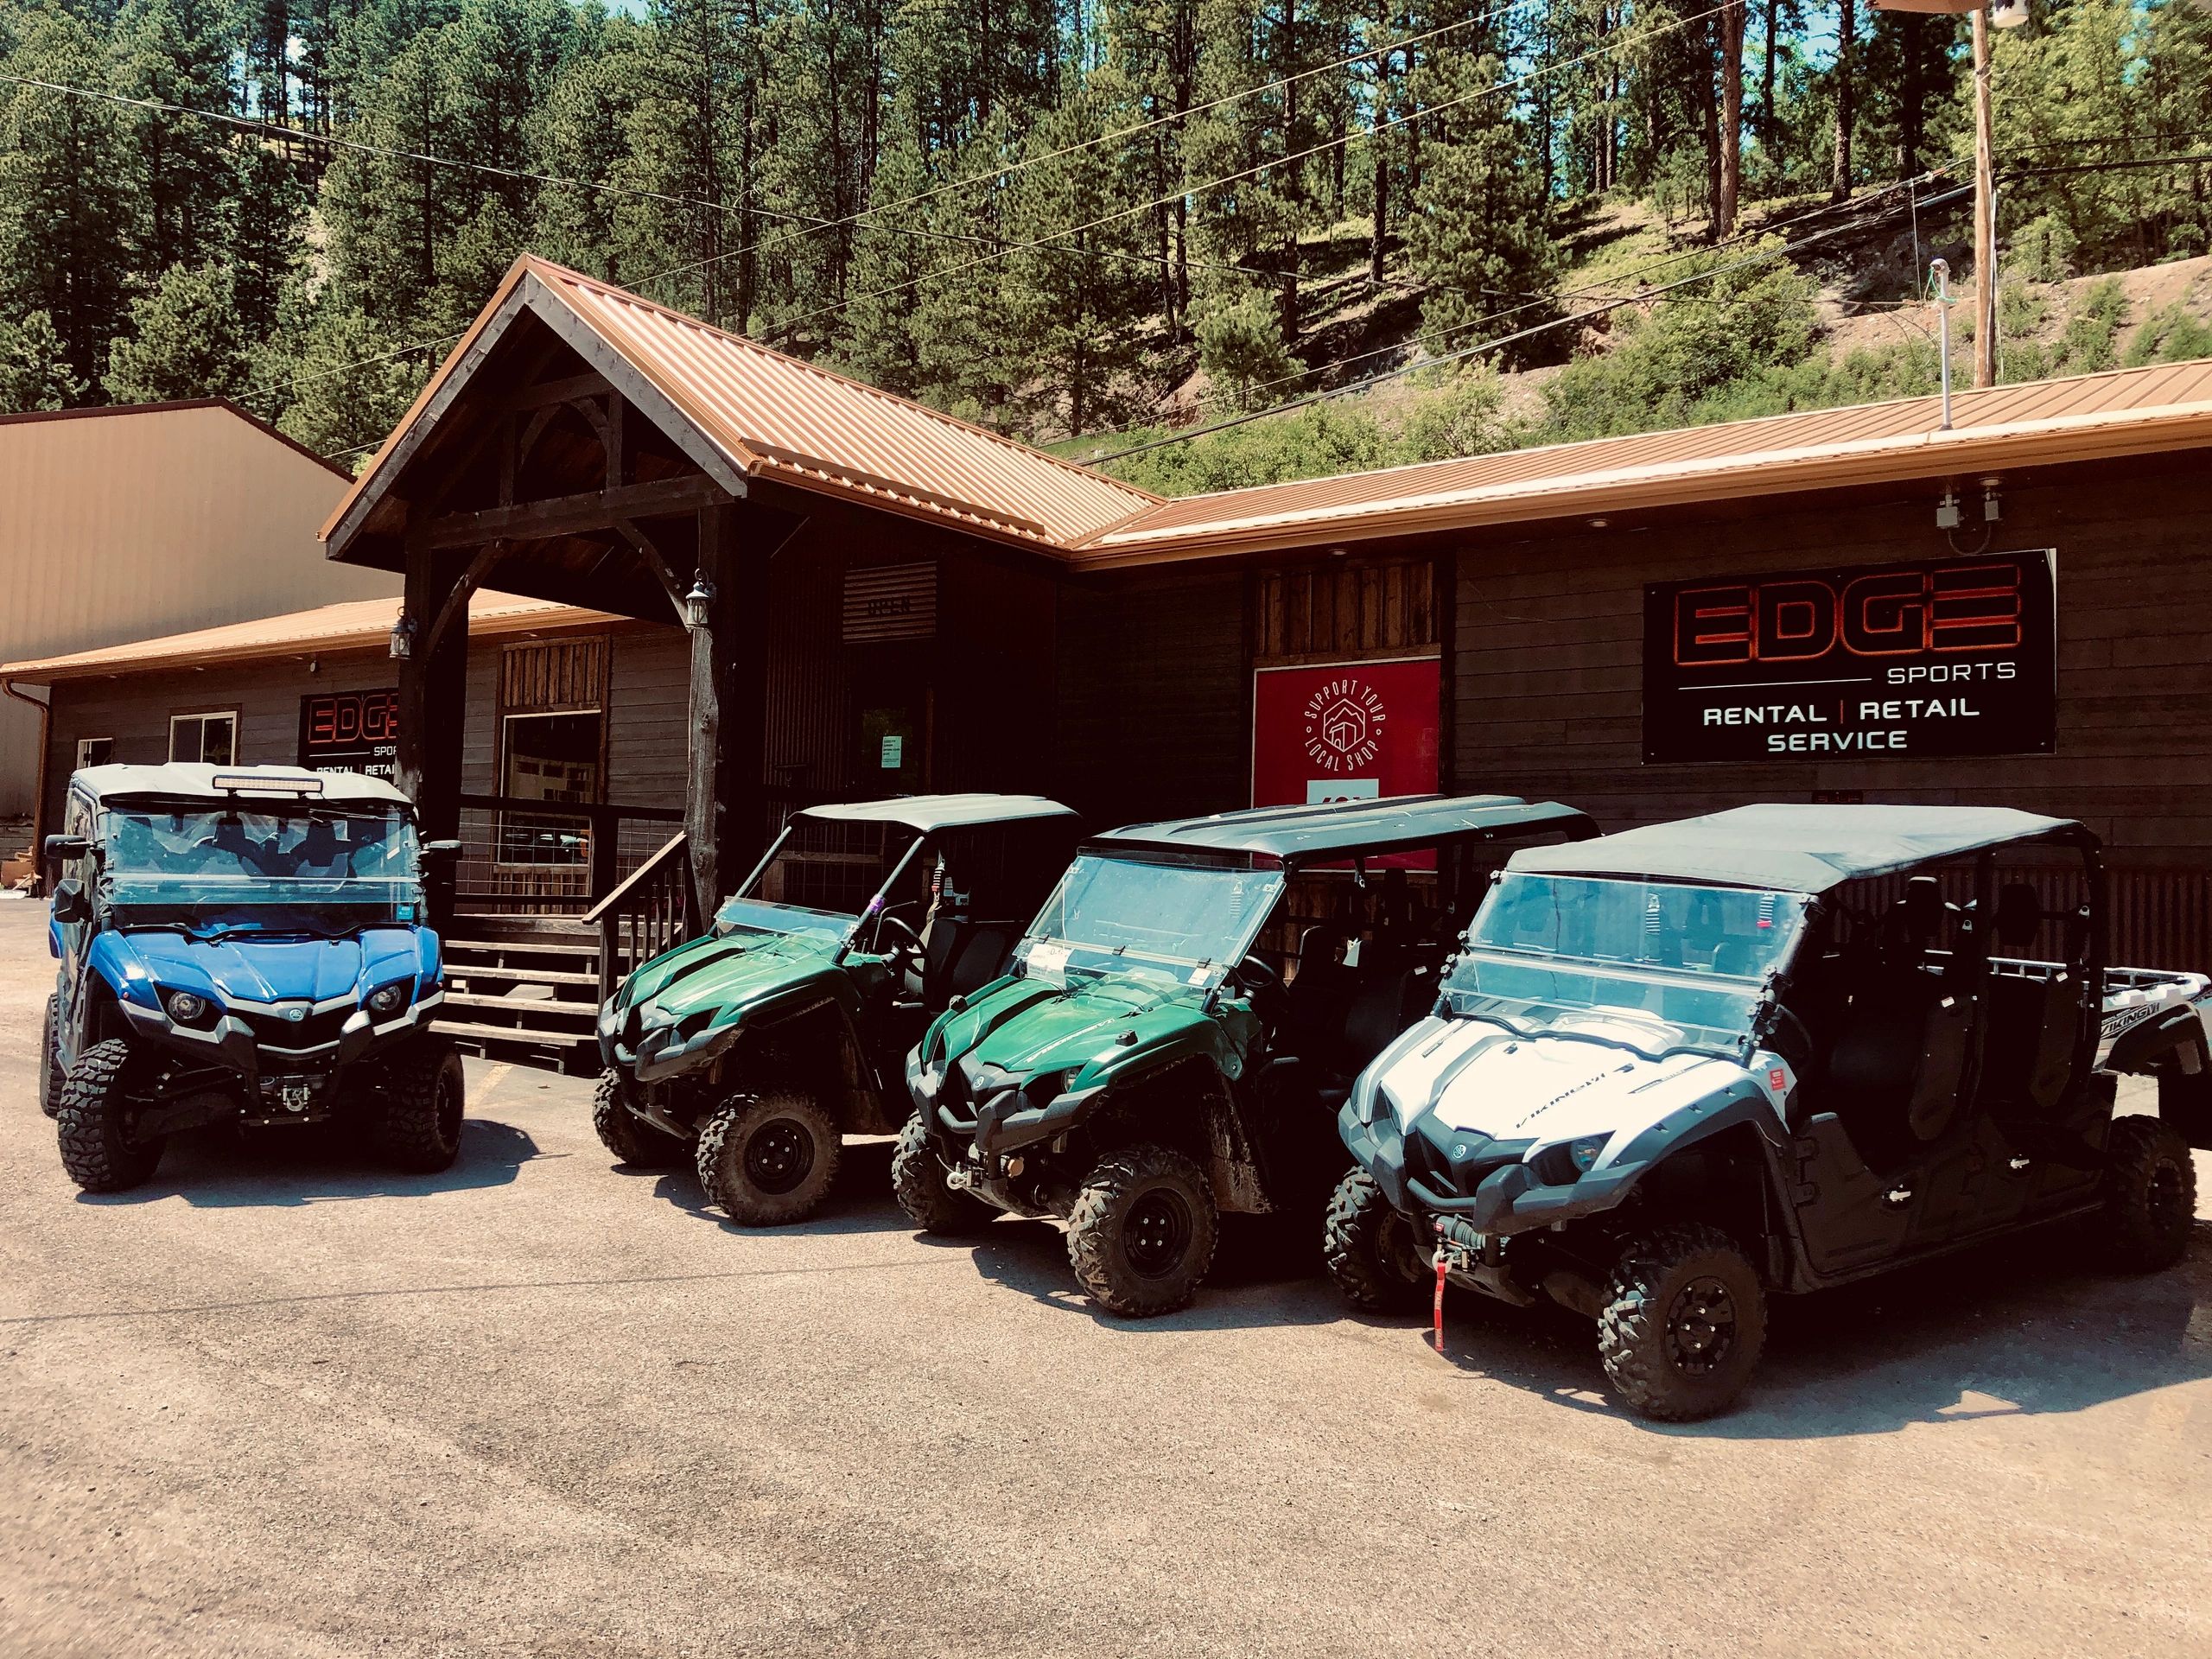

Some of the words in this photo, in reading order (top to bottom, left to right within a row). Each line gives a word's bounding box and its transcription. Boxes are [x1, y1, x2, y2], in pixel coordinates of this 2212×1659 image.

[1674, 564, 2023, 666] EDGE
[1887, 662, 2017, 684] SPORTS
[1305, 679, 1357, 719] SUPPORT
[1361, 686, 1386, 721] YOUR
[1703, 704, 1827, 726] RENTAL
[1859, 698, 1980, 721] RETAIL
[1305, 737, 1338, 771] LOCAL
[1347, 740, 1378, 771] SHOP
[1767, 730, 1909, 753] SERVICE
[365, 764, 395, 775] RETAI
